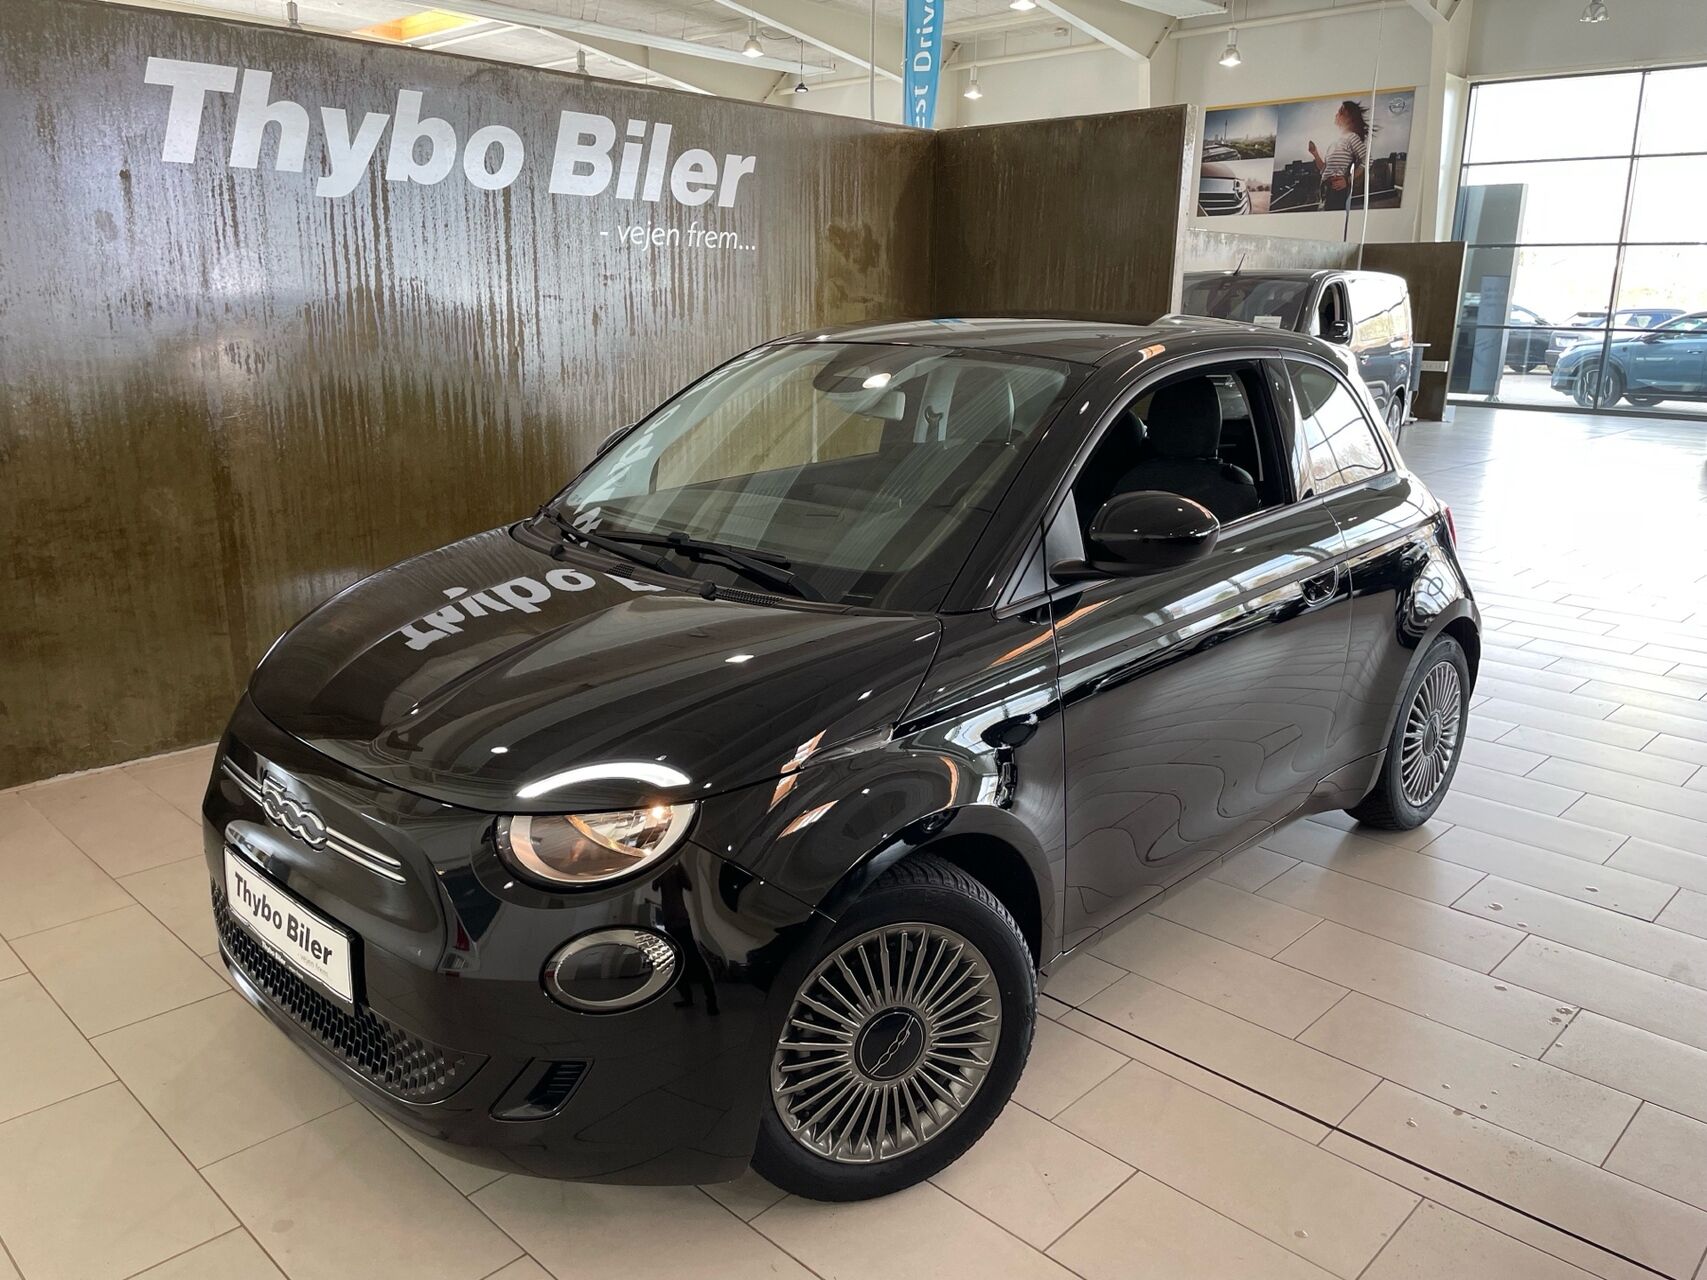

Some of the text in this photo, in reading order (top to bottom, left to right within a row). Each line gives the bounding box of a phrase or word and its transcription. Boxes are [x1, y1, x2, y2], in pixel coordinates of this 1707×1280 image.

[913, 0, 936, 72] Driv
[144, 56, 756, 209] Thybo Biler
[617, 220, 680, 252] vejen
[687, 221, 756, 251] frem...
[262, 776, 328, 850] 500
[235, 872, 283, 930] Thybo
[287, 913, 333, 966] Biler
